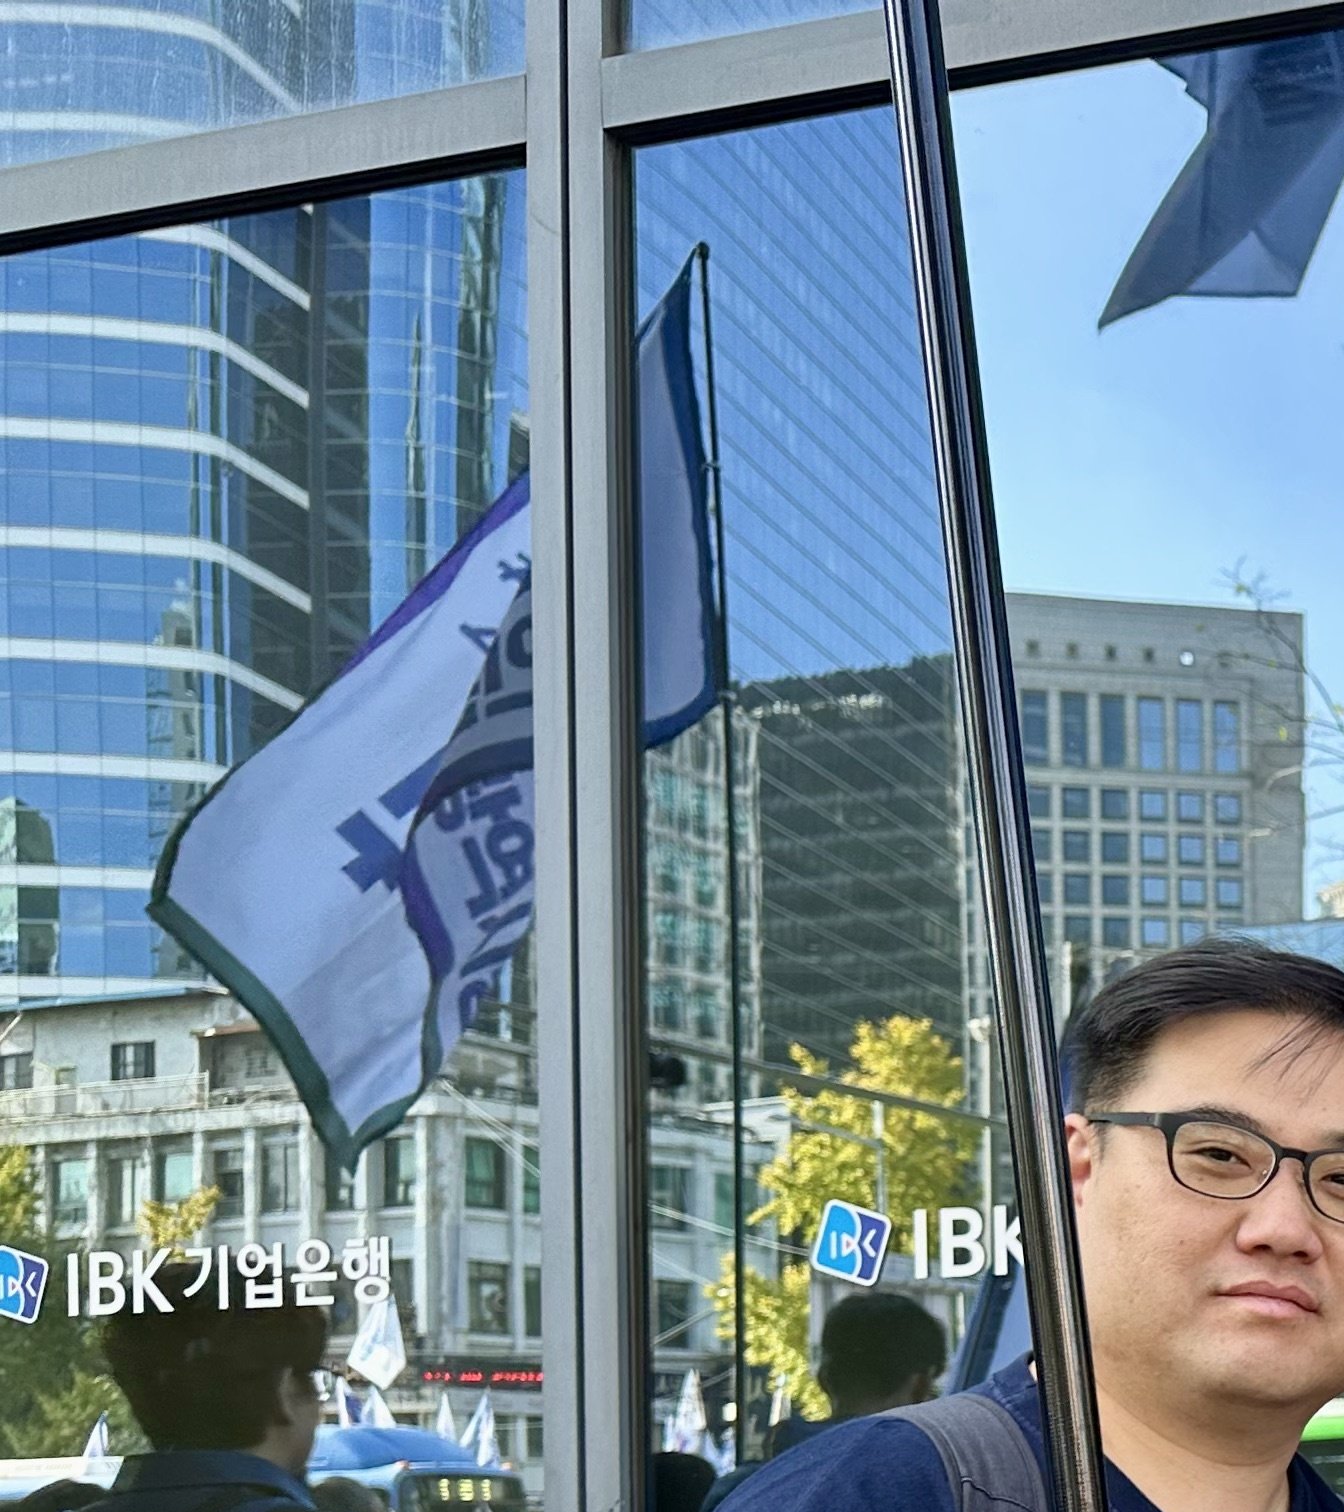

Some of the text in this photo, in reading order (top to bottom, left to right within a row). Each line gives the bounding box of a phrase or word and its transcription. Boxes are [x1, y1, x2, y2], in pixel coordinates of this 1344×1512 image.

[67, 1236, 391, 1317] IBK 기업은행
[913, 1205, 1024, 1280] IBK
